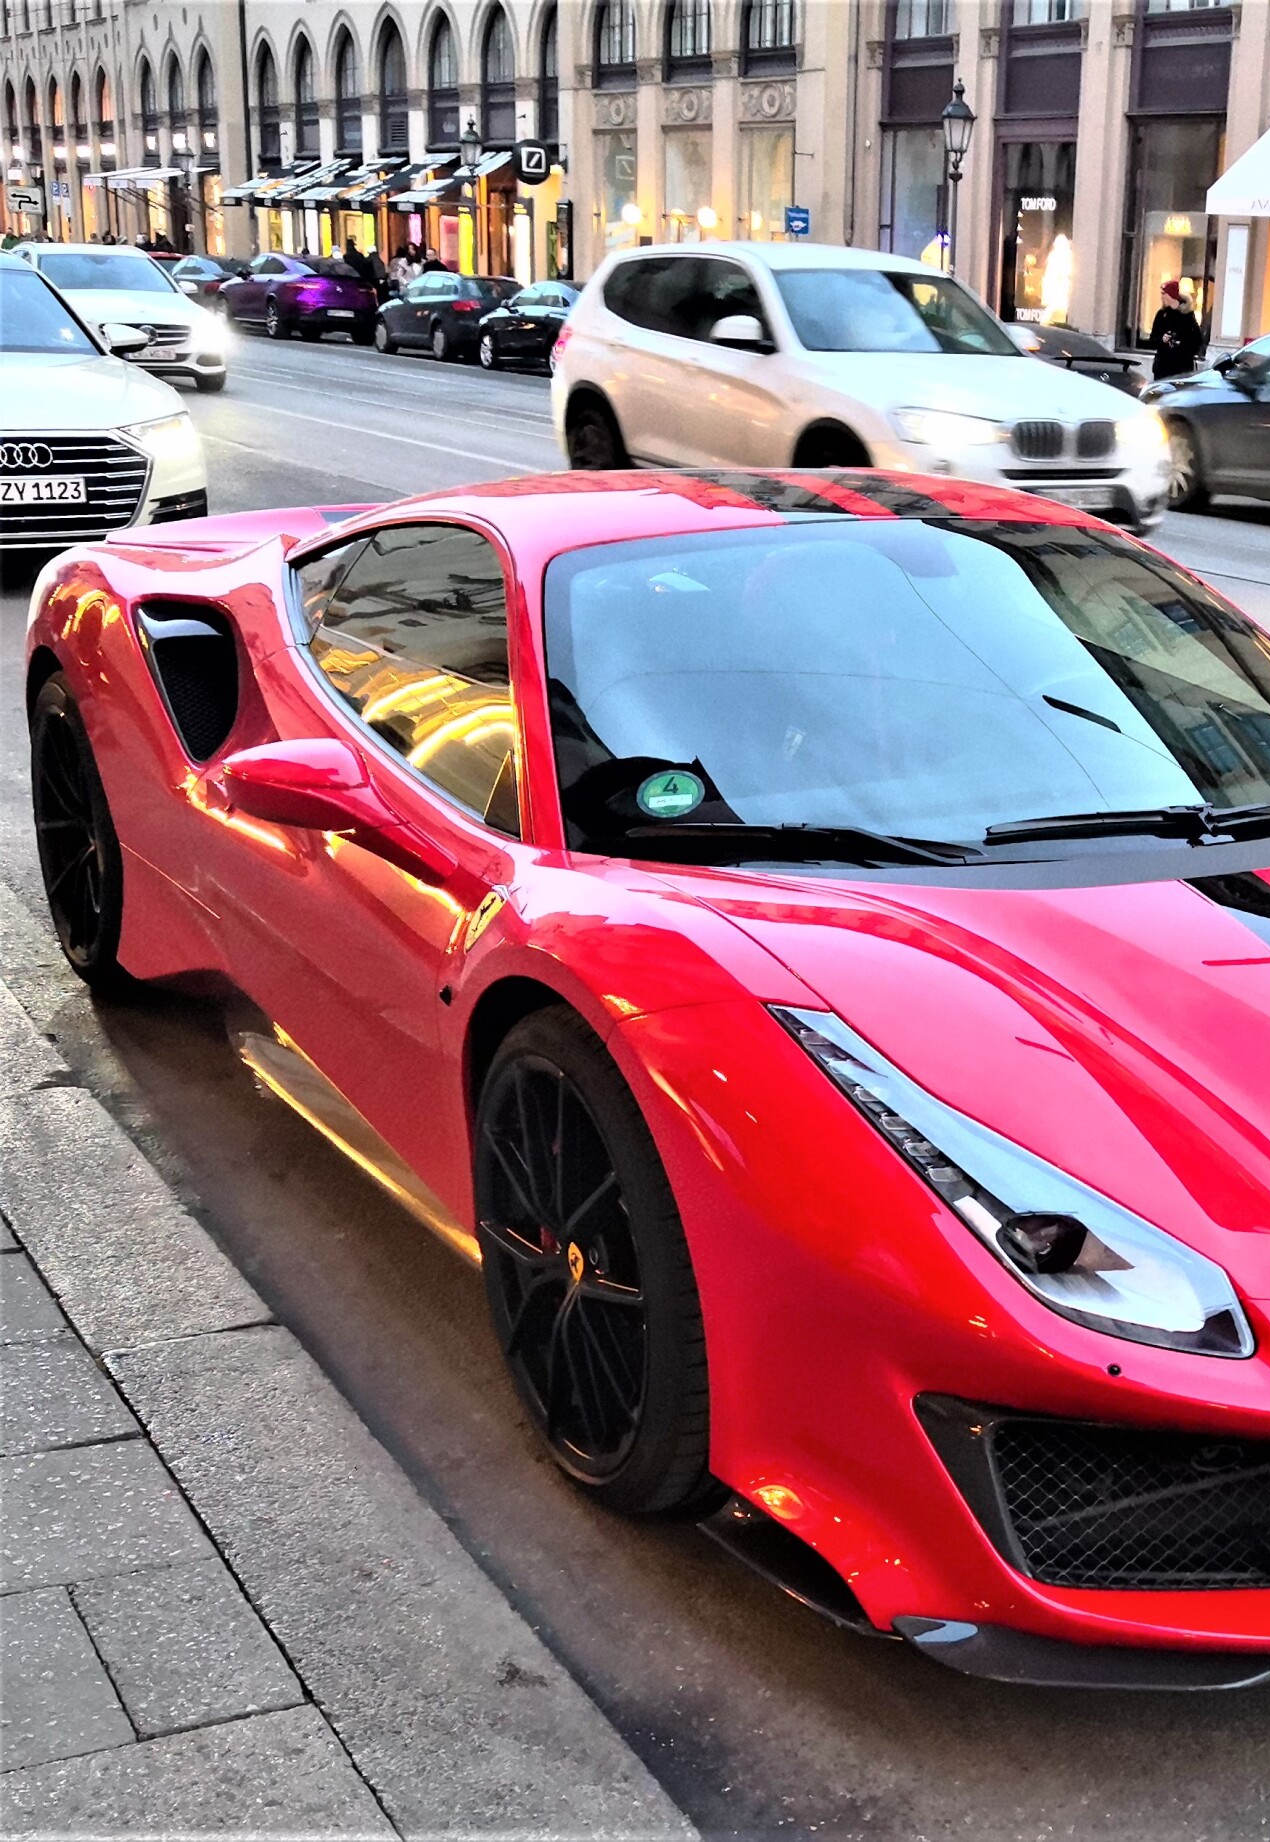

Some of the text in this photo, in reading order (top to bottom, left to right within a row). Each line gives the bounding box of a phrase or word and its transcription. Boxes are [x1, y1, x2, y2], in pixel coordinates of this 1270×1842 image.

[1021, 198, 1056, 211] TOM FORD
[0, 482, 82, 501] ZY 1123
[662, 776, 679, 793] 4
